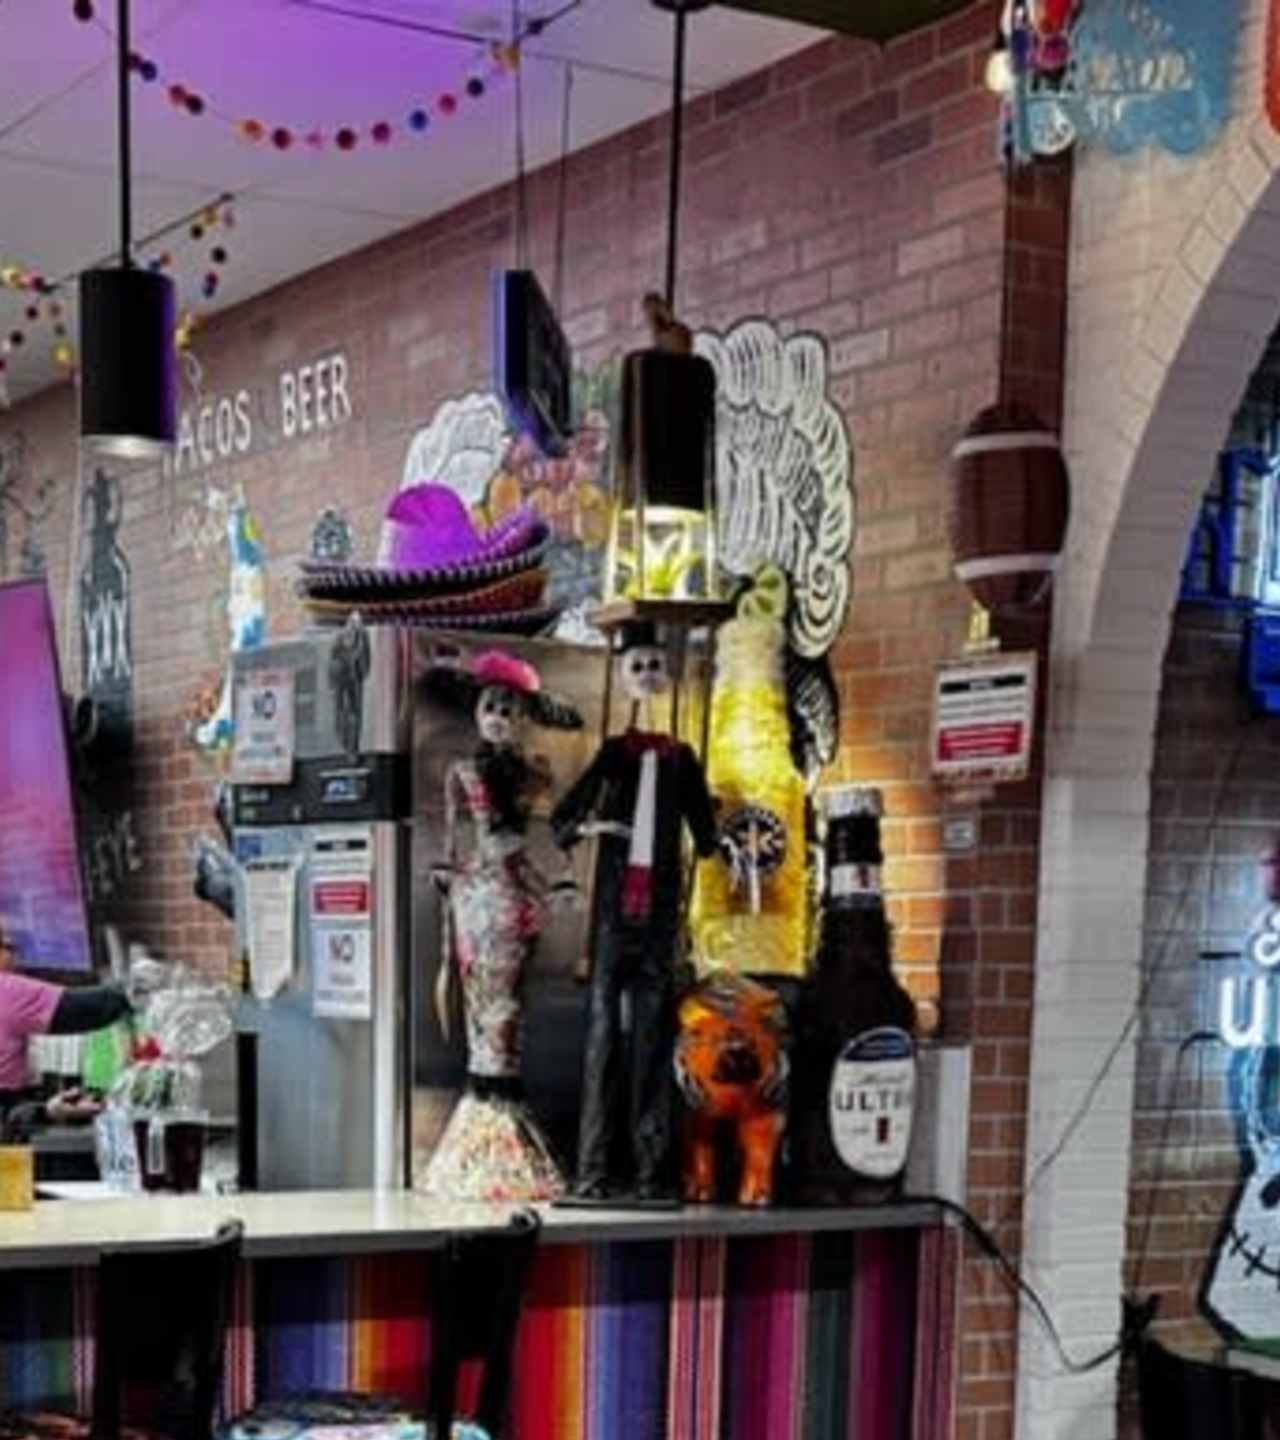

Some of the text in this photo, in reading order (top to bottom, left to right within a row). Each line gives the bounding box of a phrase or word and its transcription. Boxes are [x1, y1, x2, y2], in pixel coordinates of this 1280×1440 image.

[163, 354, 353, 476] ACOS BEER
[252, 691, 277, 719] NO
[329, 933, 355, 964] NO
